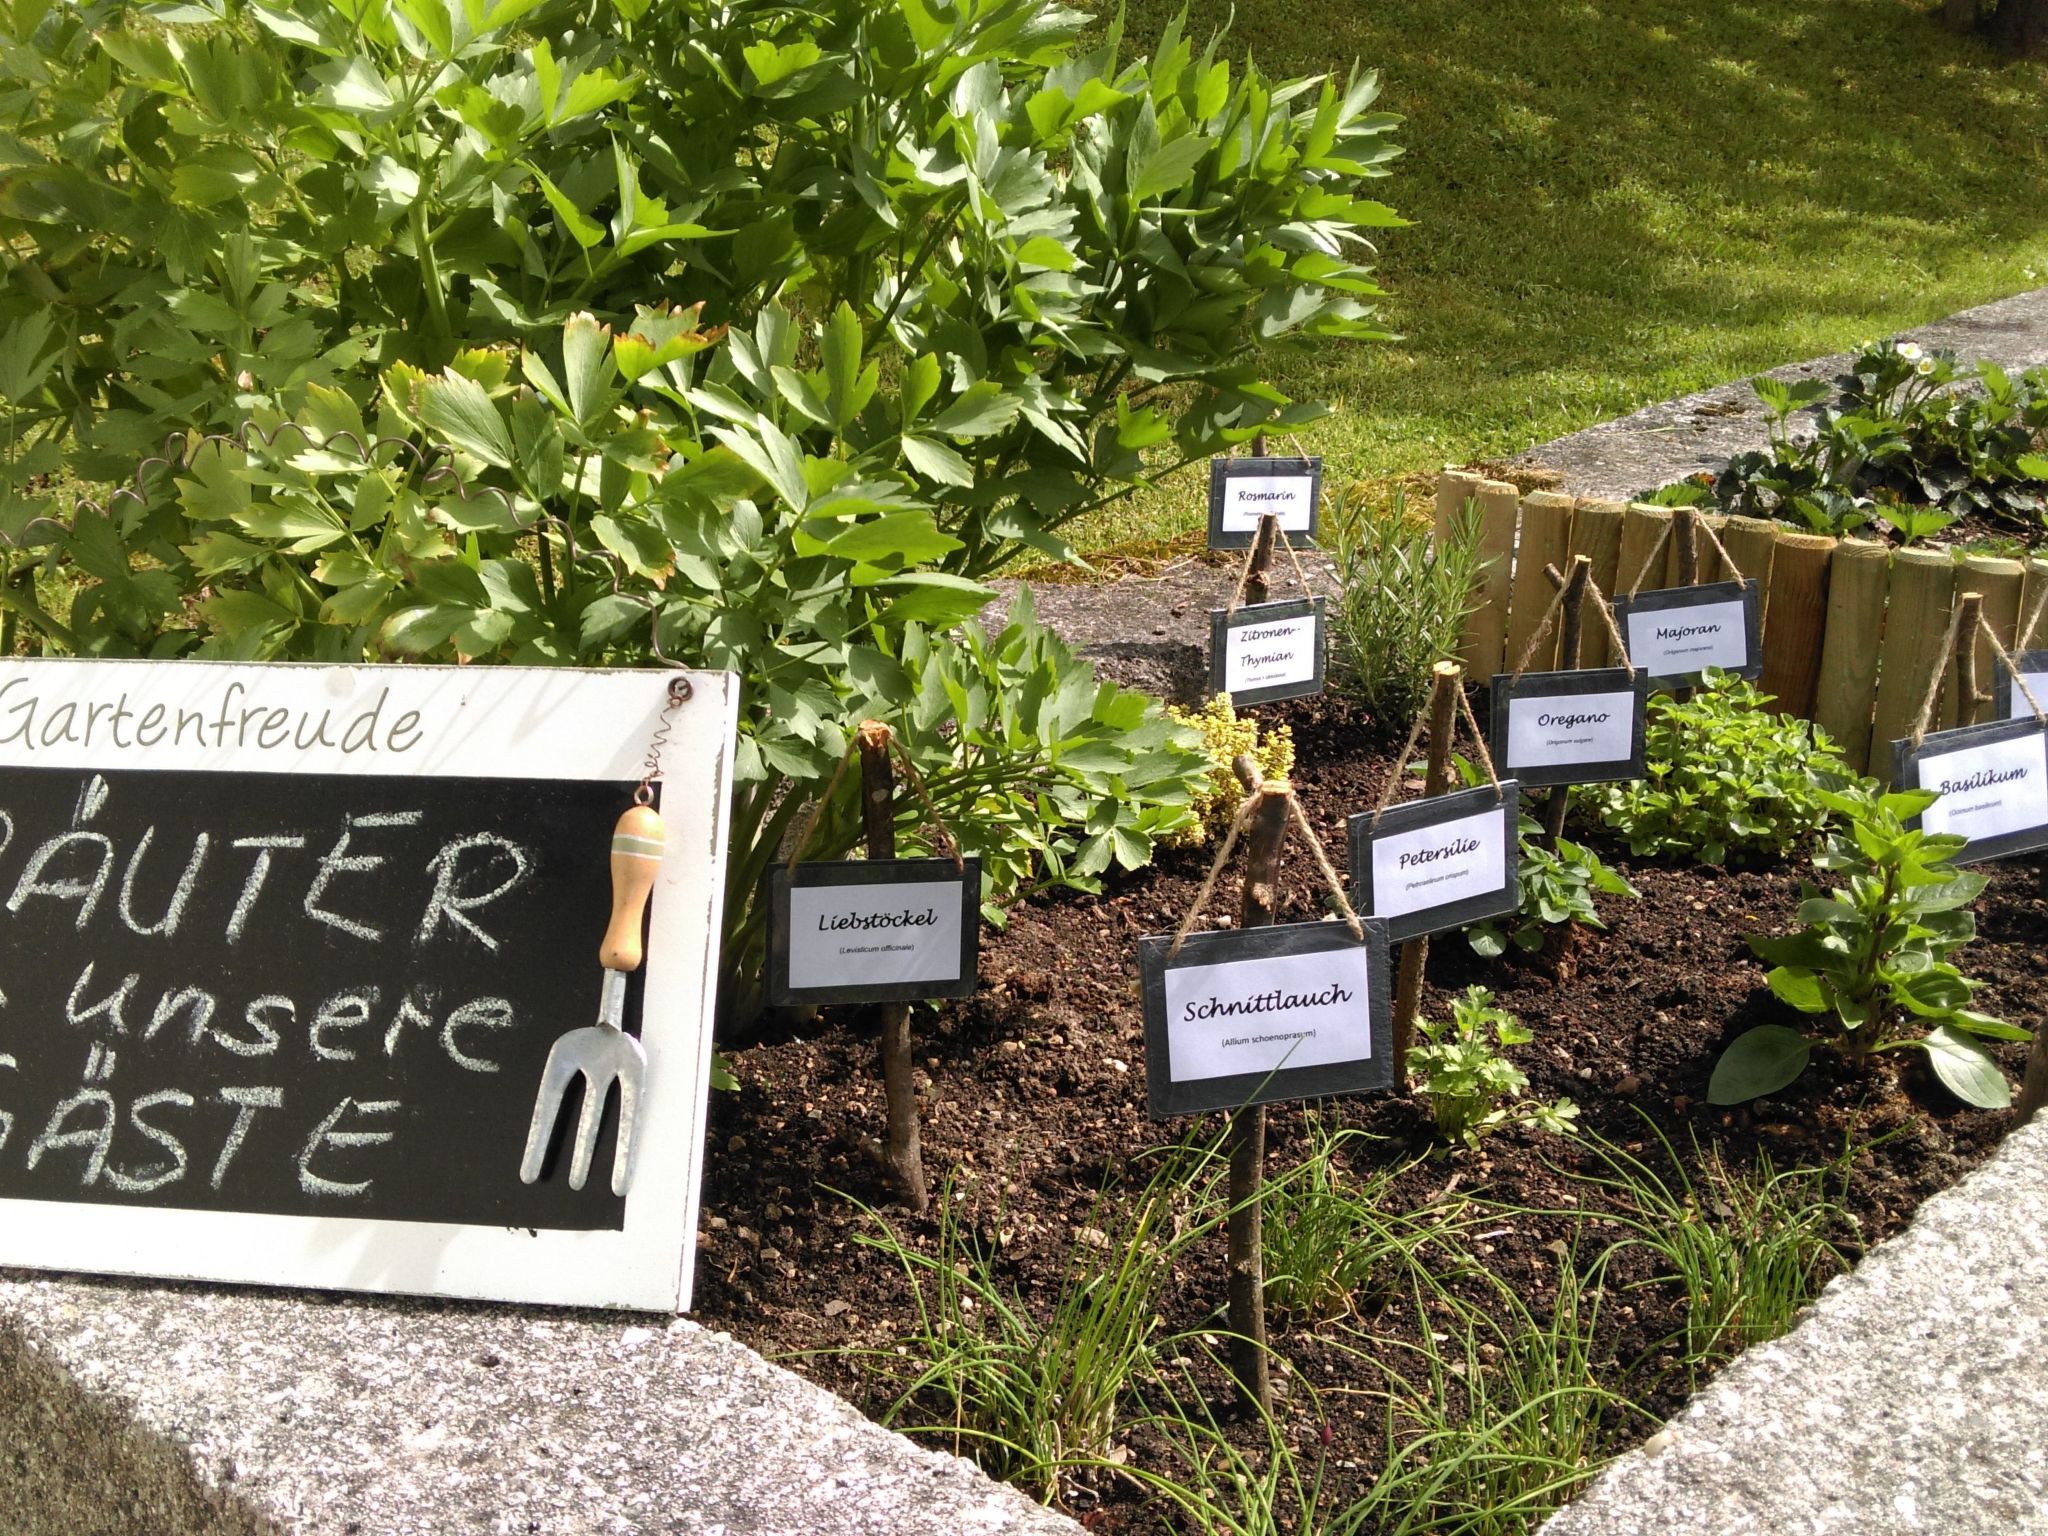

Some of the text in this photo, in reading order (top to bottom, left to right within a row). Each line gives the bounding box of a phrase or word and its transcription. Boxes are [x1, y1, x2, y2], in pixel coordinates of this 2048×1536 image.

[1238, 490, 1296, 502] Rosmarin
[1656, 623, 1721, 641] Majoran
[1241, 651, 1294, 668] Thymian
[0, 677, 424, 753] Gartenfreude
[1538, 713, 1610, 729] Oregano
[1940, 767, 2028, 796] Basilikum
[1399, 838, 1480, 870] Petersilie
[818, 908, 938, 931] Liebstöckel
[1183, 984, 1353, 1022] Schnittlauch
[66, 961, 514, 1073] unsere
[1222, 1036, 1250, 1048] (Allium
